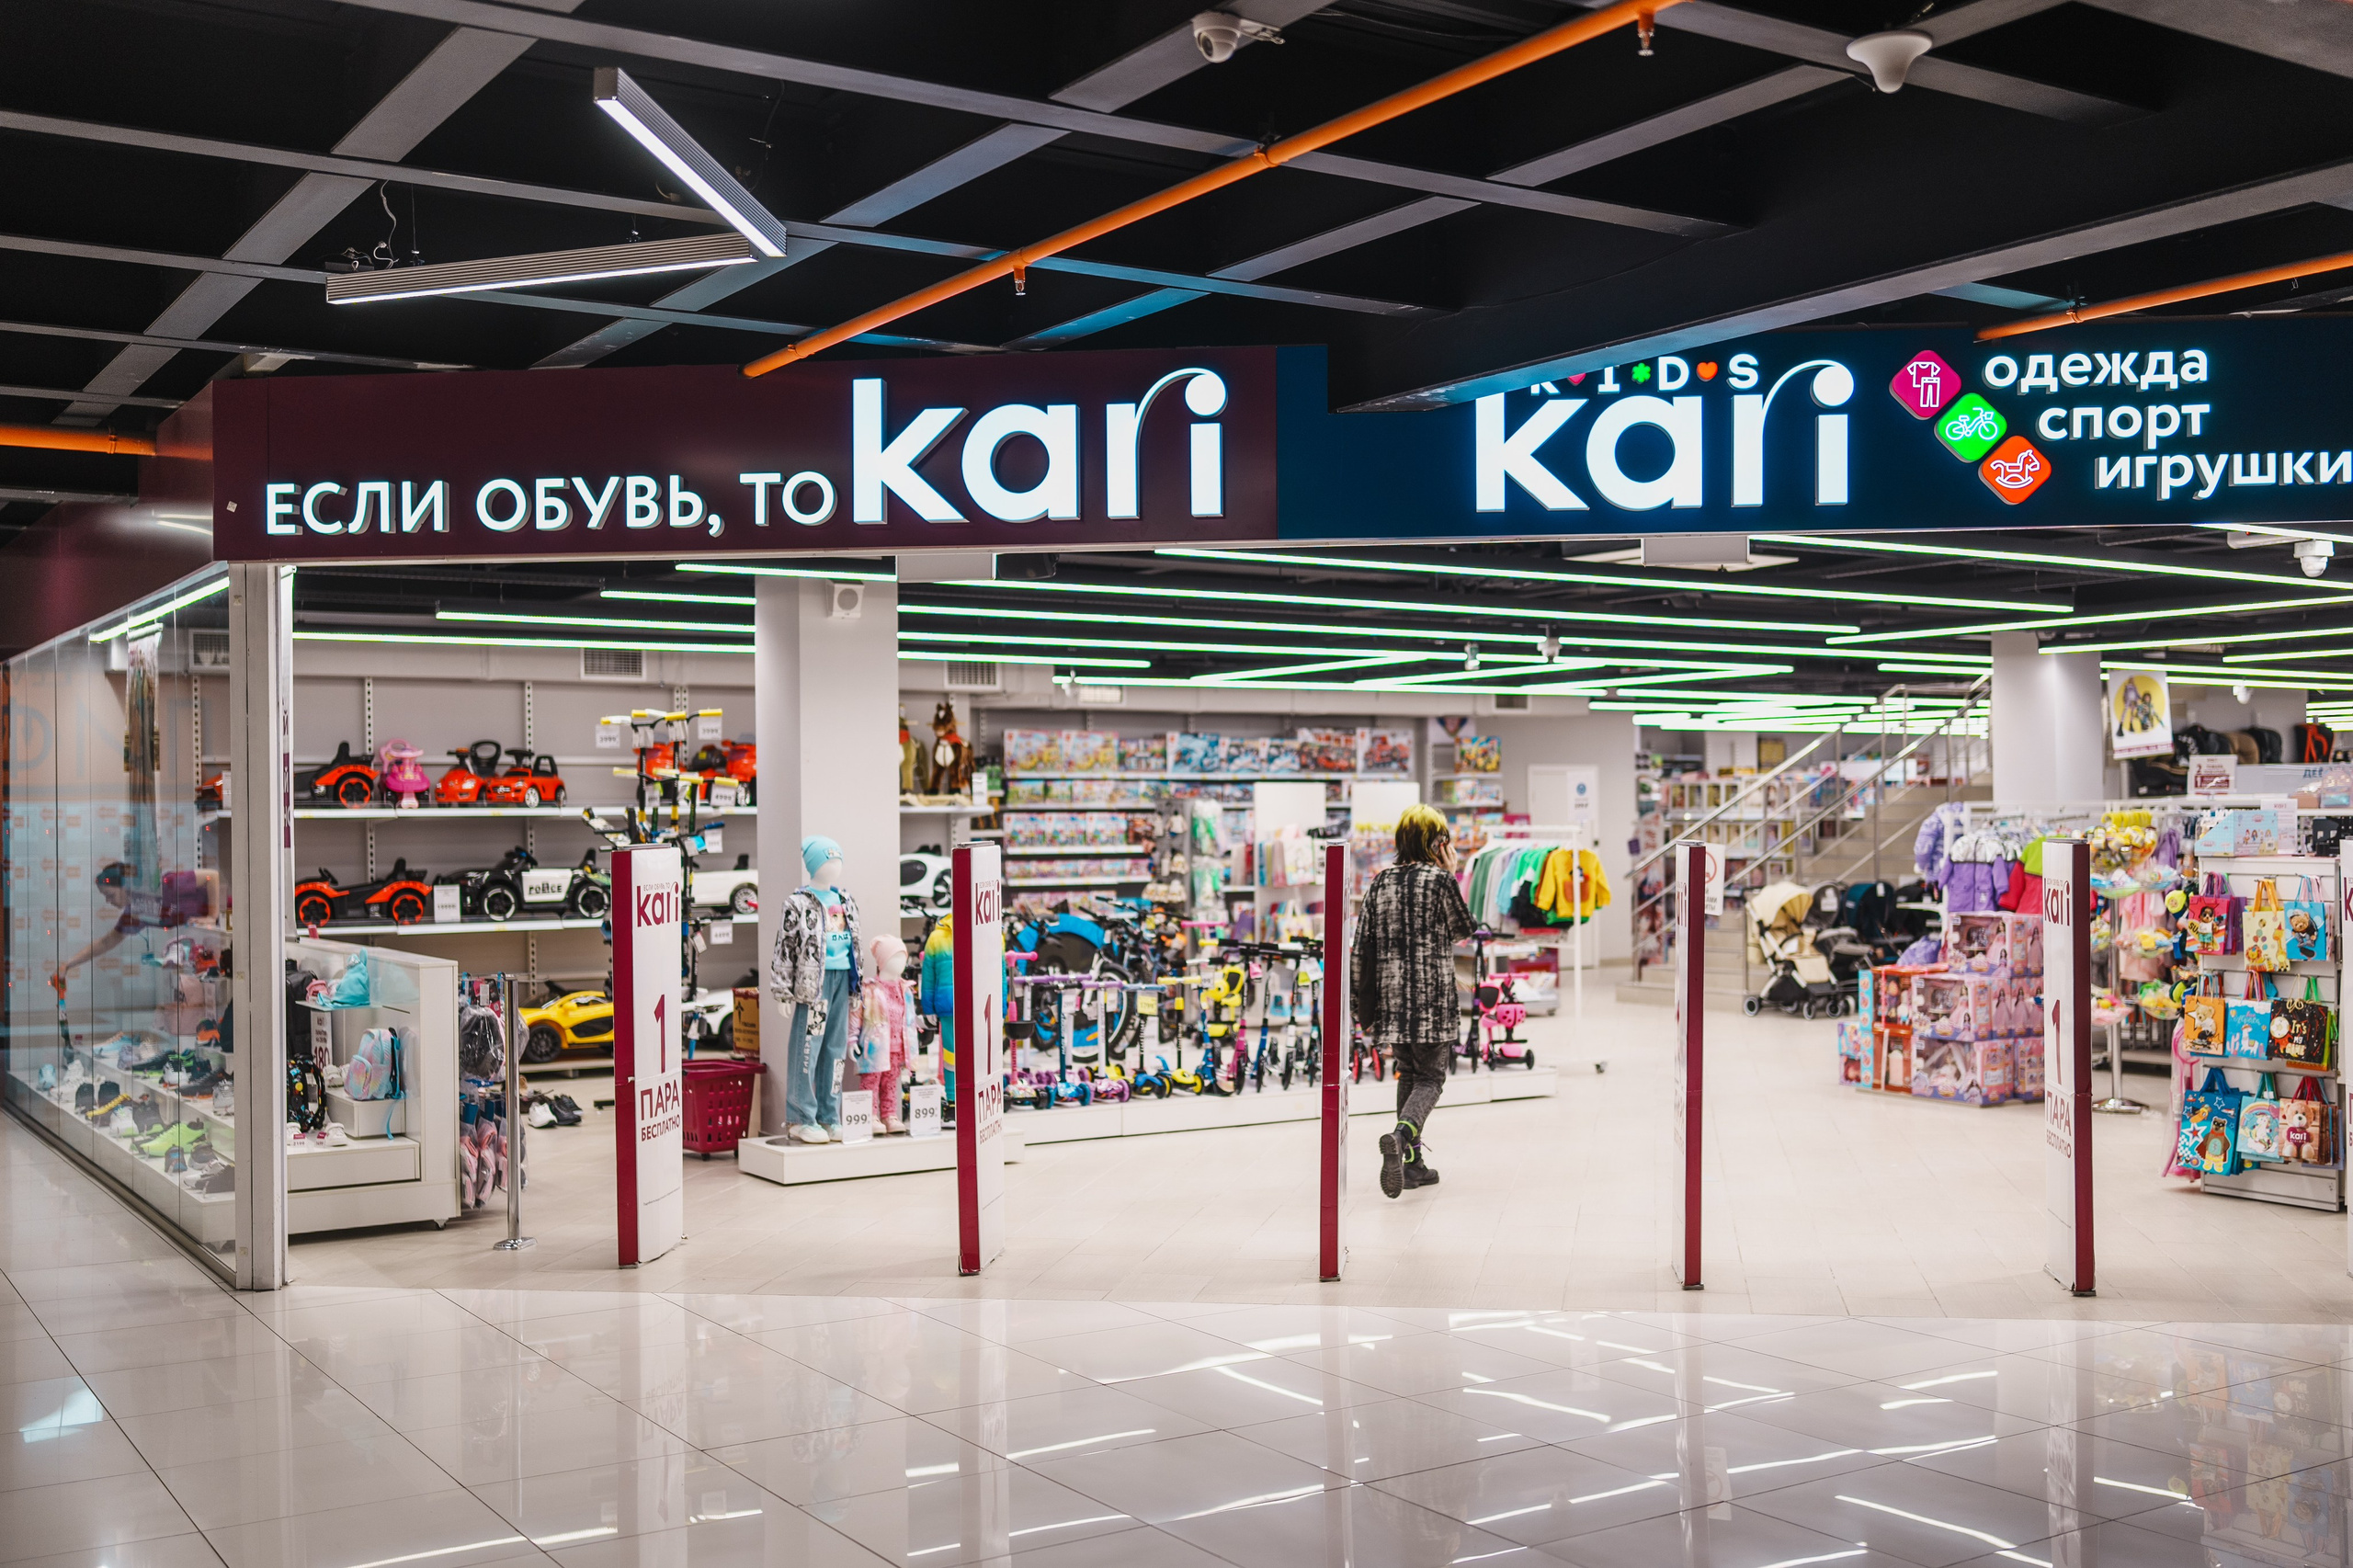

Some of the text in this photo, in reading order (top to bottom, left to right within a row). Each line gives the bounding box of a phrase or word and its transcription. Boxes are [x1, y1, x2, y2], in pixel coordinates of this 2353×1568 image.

[1983, 348, 2208, 395] одежда
[1475, 359, 1855, 512] kari
[2036, 403, 2211, 450] спорт
[267, 367, 1228, 538] ЕСЛИ ОБУВЬ, ТО kari
[2095, 449, 2353, 501] игрушки
[636, 881, 679, 927] kari
[975, 879, 1000, 926] kari
[2043, 878, 2070, 926] kari
[654, 994, 665, 1074] 1
[983, 994, 992, 1075] 1
[640, 1079, 680, 1121] ПАРА
[978, 1081, 1003, 1123] ПАРА
[2046, 1090, 2072, 1137] ПАРА
[641, 1114, 680, 1142] БЕСПЛАТНО
